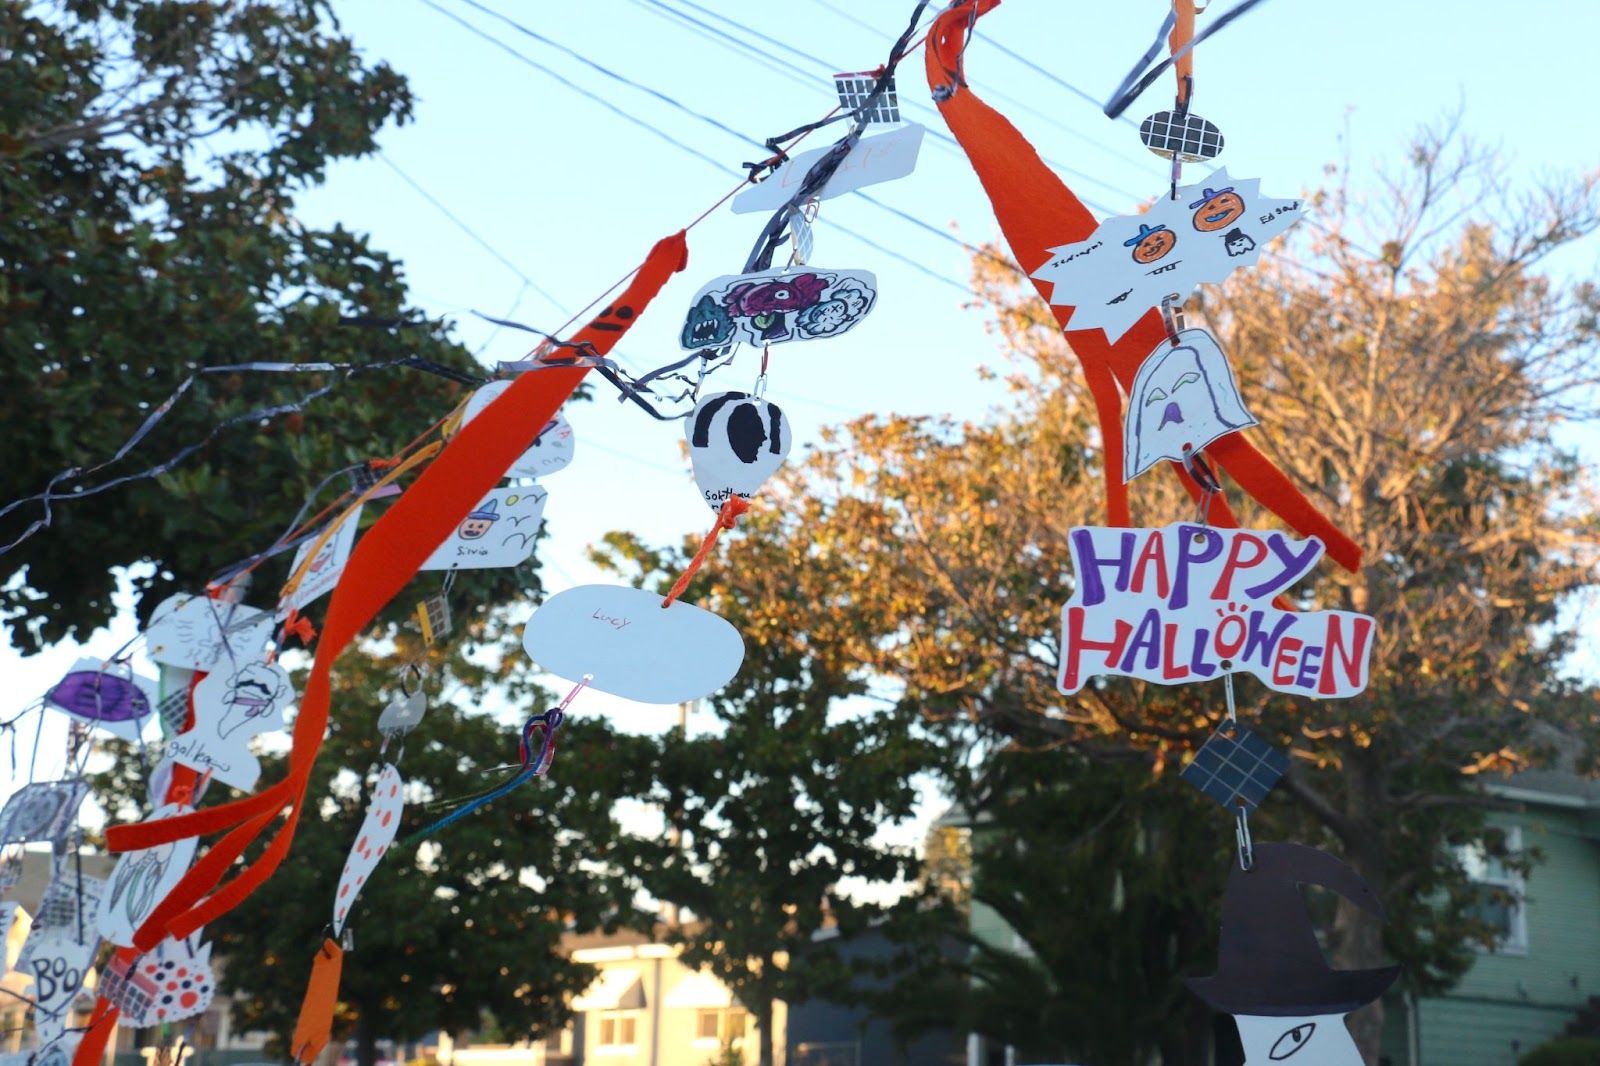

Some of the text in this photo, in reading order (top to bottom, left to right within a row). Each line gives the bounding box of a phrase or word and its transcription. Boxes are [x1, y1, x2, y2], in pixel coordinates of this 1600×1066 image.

[1071, 524, 1321, 610] HAPPY
[592, 608, 632, 630] Lucy
[1063, 604, 1371, 695] HALLOWEEN
